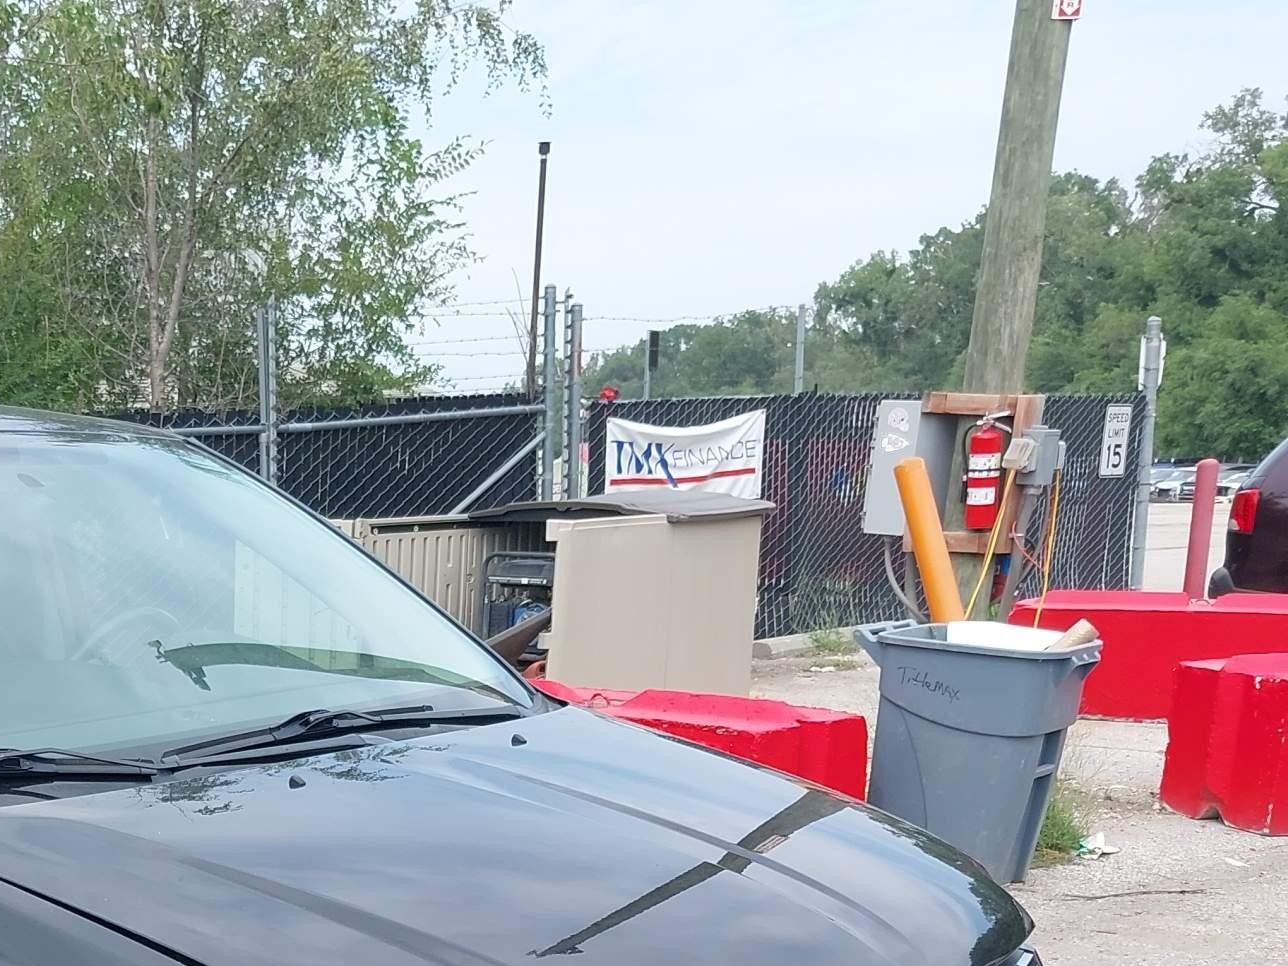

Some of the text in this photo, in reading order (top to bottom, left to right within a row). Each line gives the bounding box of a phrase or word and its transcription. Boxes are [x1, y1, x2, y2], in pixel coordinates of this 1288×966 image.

[1107, 412, 1129, 423] SPEED
[1107, 427, 1126, 439] LIMIT
[611, 439, 758, 488] TMX FINANCE
[1106, 443, 1123, 469] 15
